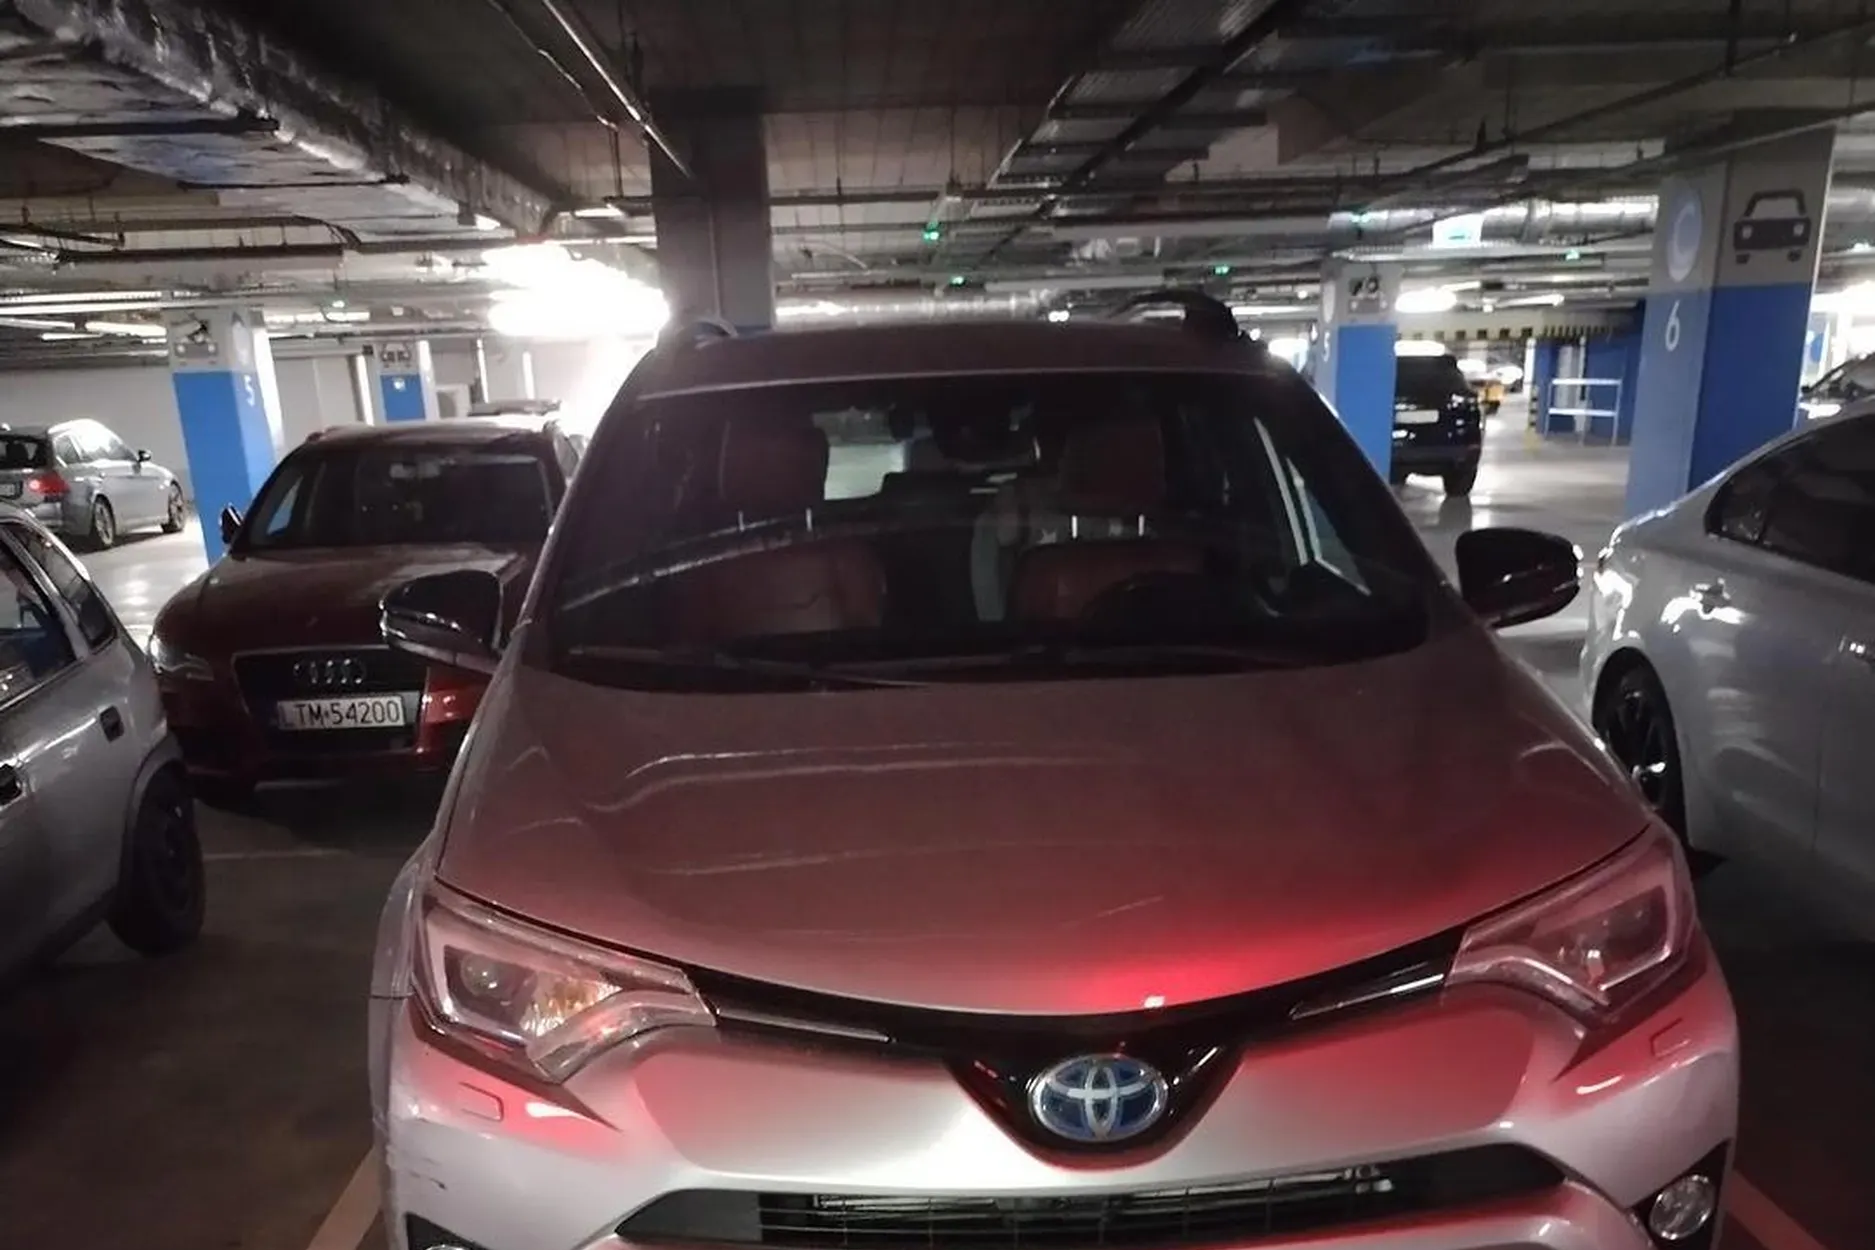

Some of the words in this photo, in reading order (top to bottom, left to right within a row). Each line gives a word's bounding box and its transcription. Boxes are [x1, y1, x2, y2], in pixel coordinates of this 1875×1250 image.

[1665, 300, 1680, 352] 6
[243, 374, 255, 407] 5
[330, 699, 400, 725] 54200
